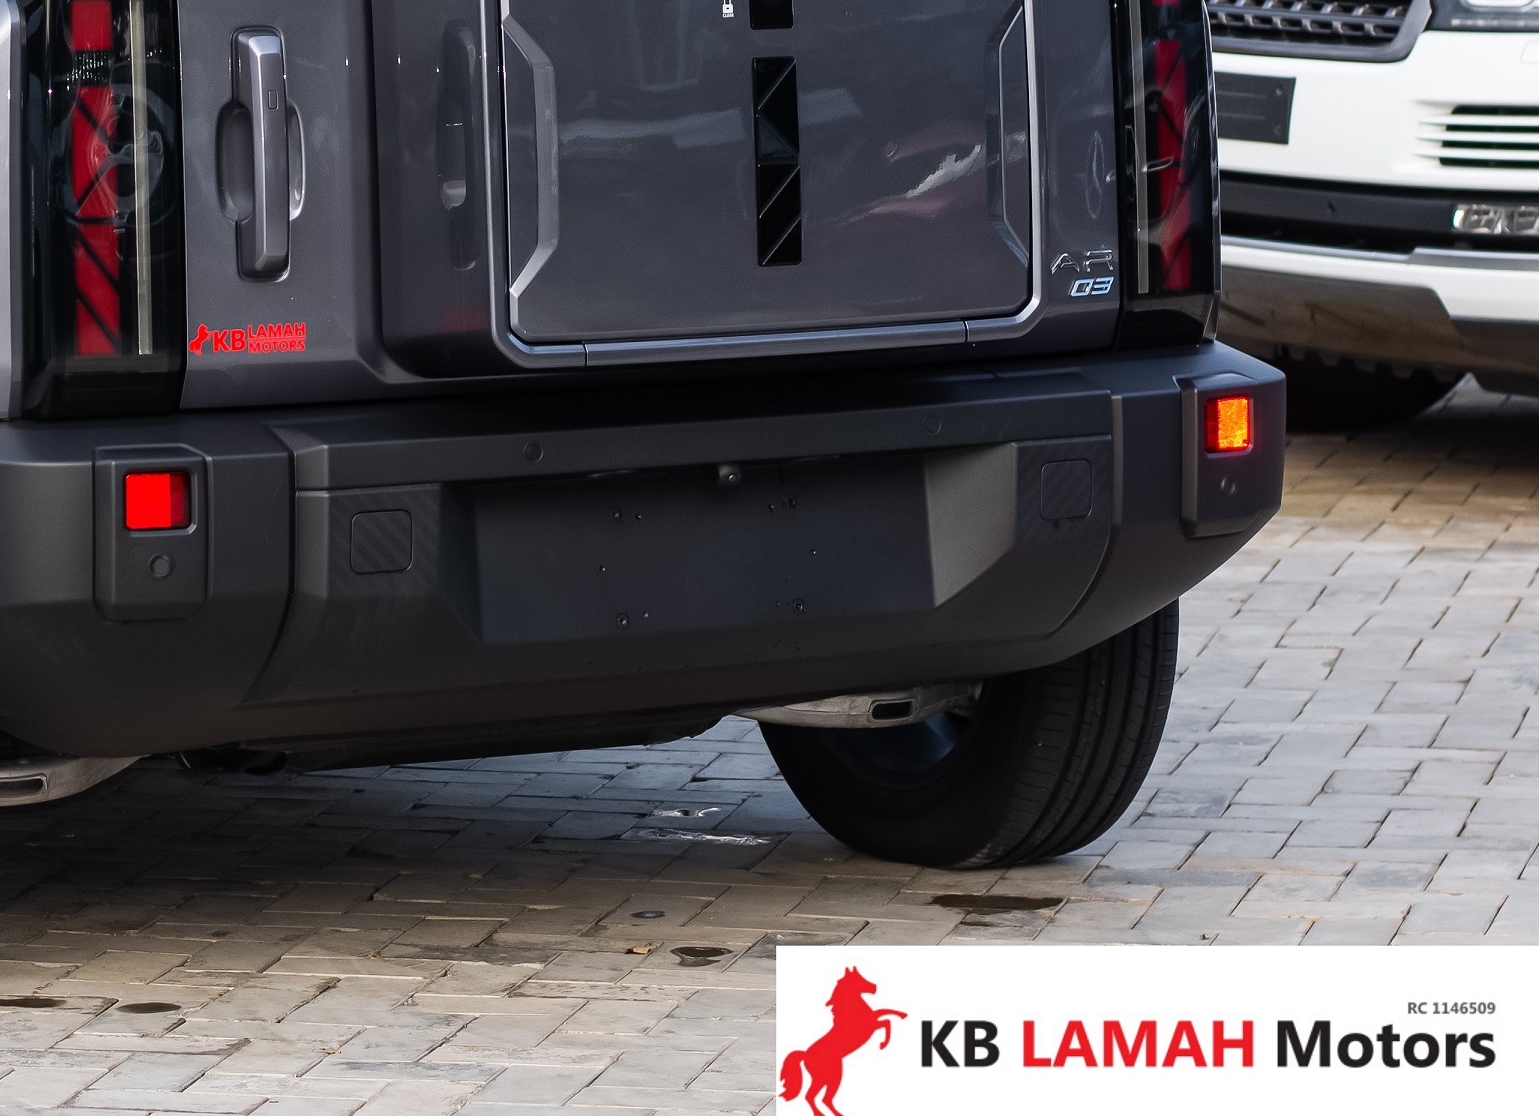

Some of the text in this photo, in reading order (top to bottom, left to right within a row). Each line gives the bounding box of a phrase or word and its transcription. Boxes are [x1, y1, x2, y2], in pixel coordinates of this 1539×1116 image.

[1068, 276, 1115, 298] 03
[212, 322, 307, 353] KB LAMAH
[247, 339, 306, 354] MOTORS
